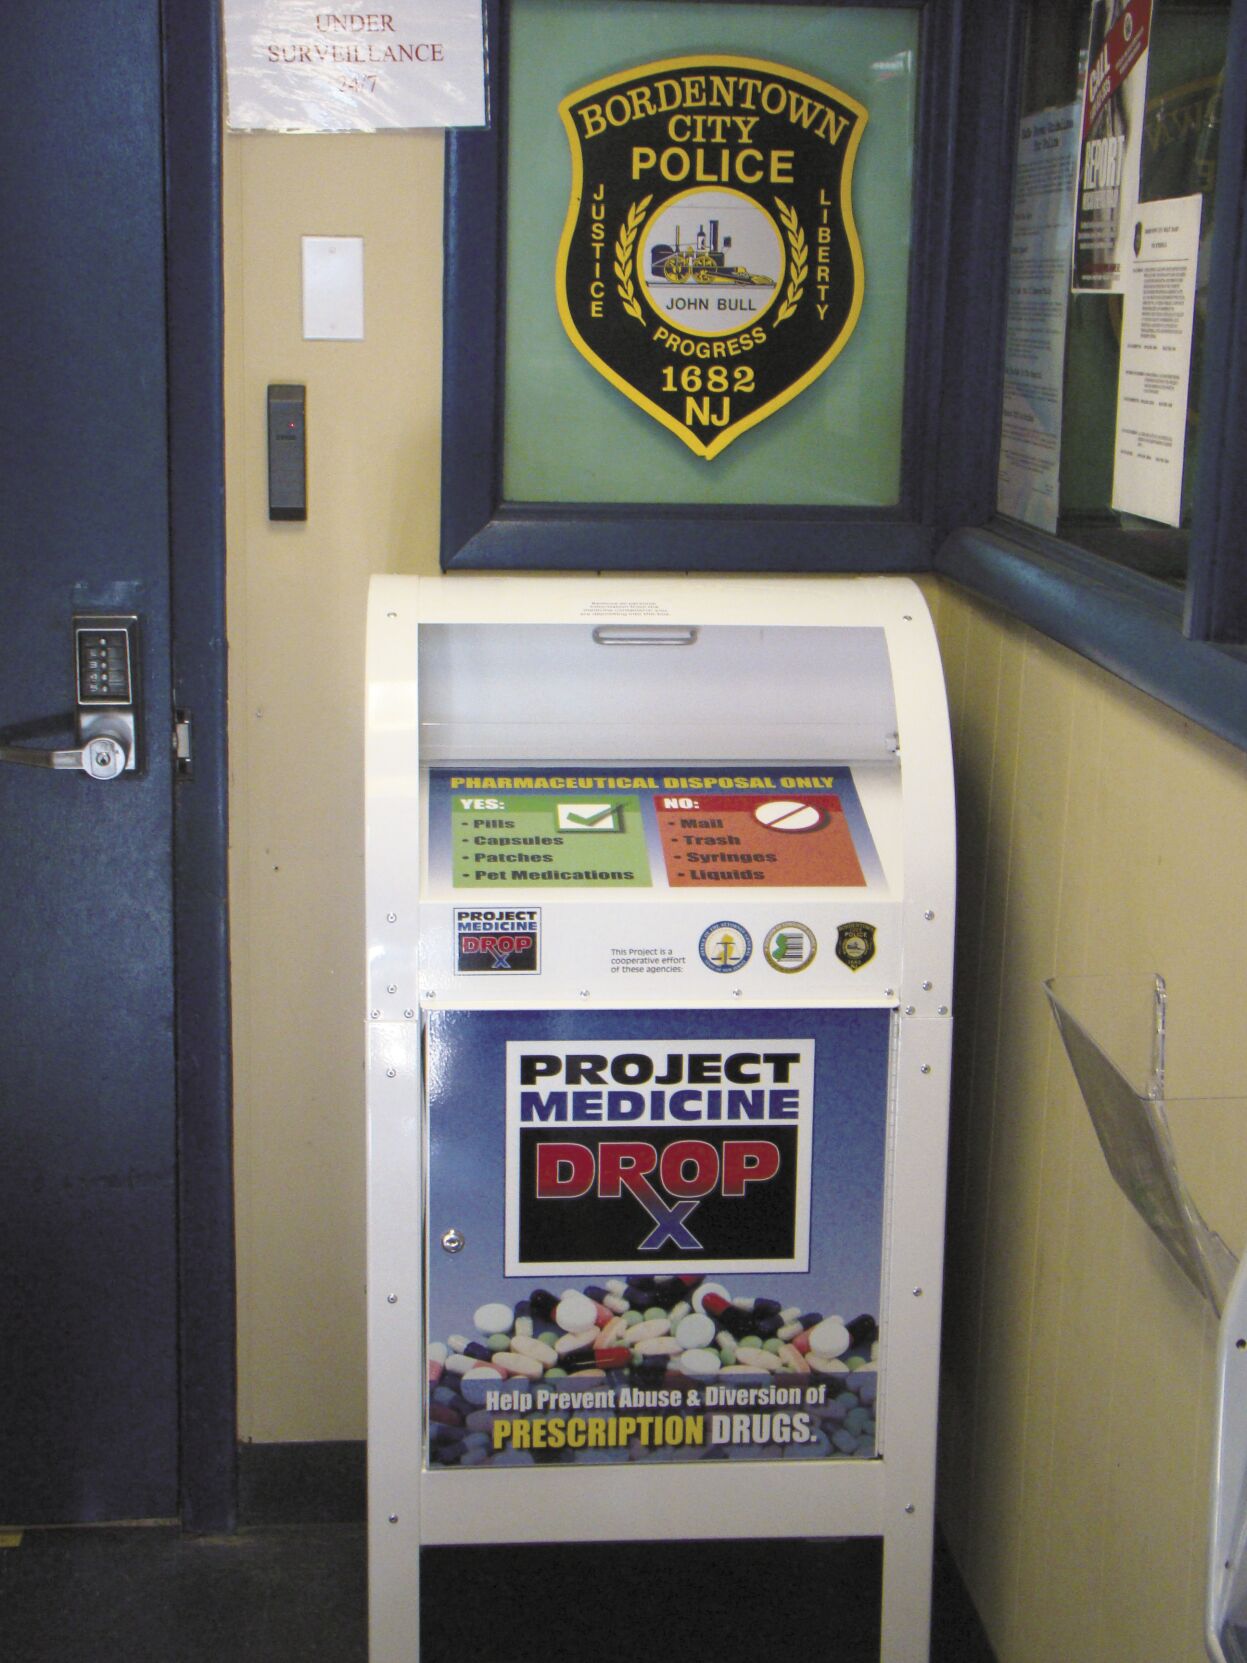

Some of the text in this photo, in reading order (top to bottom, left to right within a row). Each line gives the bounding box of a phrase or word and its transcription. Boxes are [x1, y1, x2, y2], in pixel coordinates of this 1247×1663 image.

[316, 14, 395, 32] UNDER
[268, 43, 444, 63] SURVEILLANCE
[578, 75, 849, 146] BORDENTOWN
[668, 115, 759, 143] CITY
[632, 147, 795, 183] POLICE
[590, 184, 605, 318] JUSTICE
[816, 189, 832, 321] LIBERTY
[666, 297, 757, 312] JOHN BULL
[653, 326, 767, 359] PROGRESS
[661, 366, 756, 392] 1682
[685, 396, 731, 427] NJ
[451, 777, 834, 790] PHARMACEUTICAL DISPOSAL ONLY
[460, 798, 505, 810] YES:
[664, 798, 700, 809] NO:
[473, 819, 516, 829] Pills
[680, 819, 724, 829] Mail
[474, 836, 564, 847] Capsules
[683, 835, 742, 846] Trash
[475, 853, 554, 863] Patches
[687, 853, 778, 864] Syringes
[475, 870, 634, 881] Pet Medications
[690, 869, 765, 881] Liquids
[457, 911, 537, 921] PROJECT
[457, 921, 538, 932] MEDICINE
[462, 936, 533, 954] DROP
[610, 948, 627, 956] This
[629, 948, 657, 957] Project
[660, 948, 666, 956] is
[611, 956, 687, 964] cooperative effort
[611, 965, 620, 973] of
[622, 965, 645, 973] these
[520, 1053, 800, 1086] PROJECT
[520, 1089, 800, 1122] MEDICINE
[536, 1140, 780, 1199] DROP
[486, 1384, 826, 1412] Help Prevent Abuse & Diversion of
[493, 1413, 818, 1449] PRESCRIPTION DRUGS.
